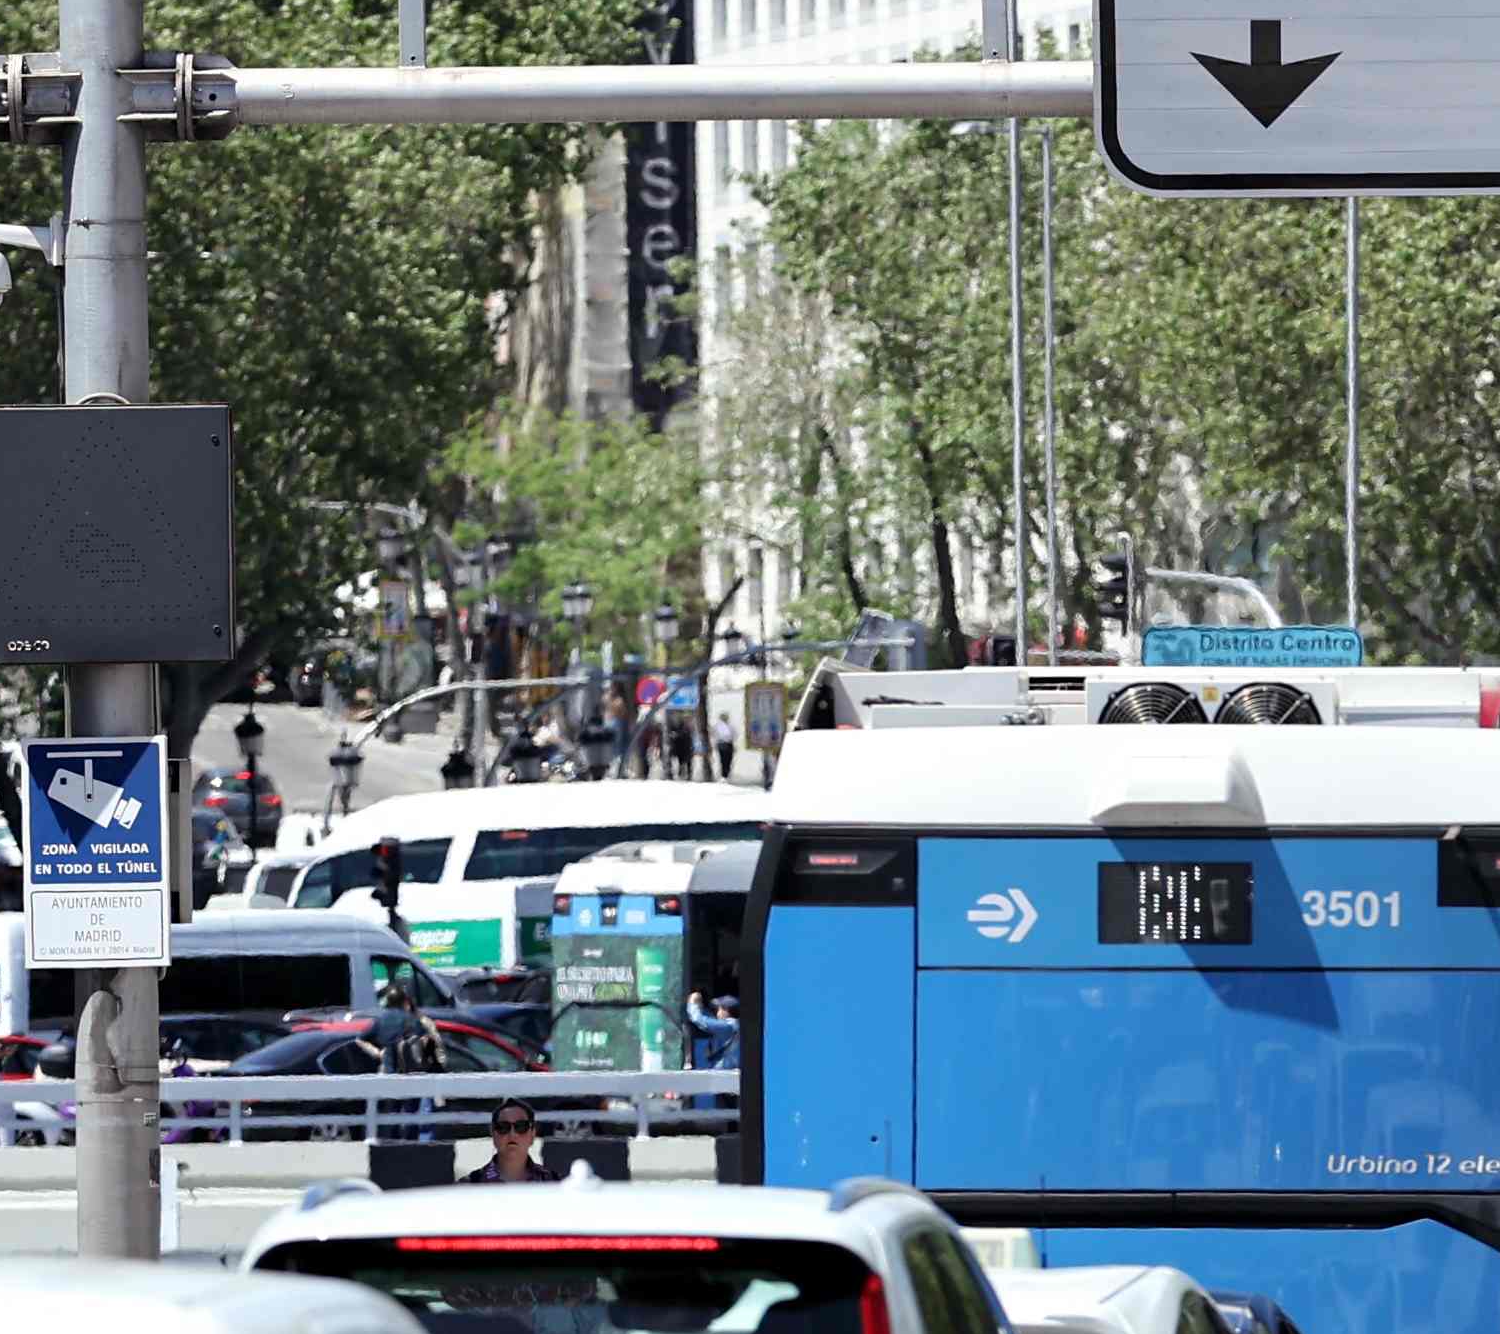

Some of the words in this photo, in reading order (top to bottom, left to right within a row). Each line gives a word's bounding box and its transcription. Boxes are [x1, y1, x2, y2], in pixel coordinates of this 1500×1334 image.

[1201, 633, 1274, 652] Distrito
[1281, 634, 1356, 652] Centro
[42, 844, 77, 855] ZONA
[91, 843, 149, 854] VIGILADA
[35, 864, 51, 875] EN
[57, 864, 92, 875] TODO
[98, 863, 112, 874] EL
[117, 860, 157, 874] TÚNEL
[51, 897, 142, 909] AYUNTAMIENTO
[1302, 890, 1402, 927] 3501
[90, 913, 105, 925] DE
[74, 930, 122, 942] MADRID
[1327, 1154, 1418, 1174] Urbino
[1426, 1154, 1451, 1174] 12
